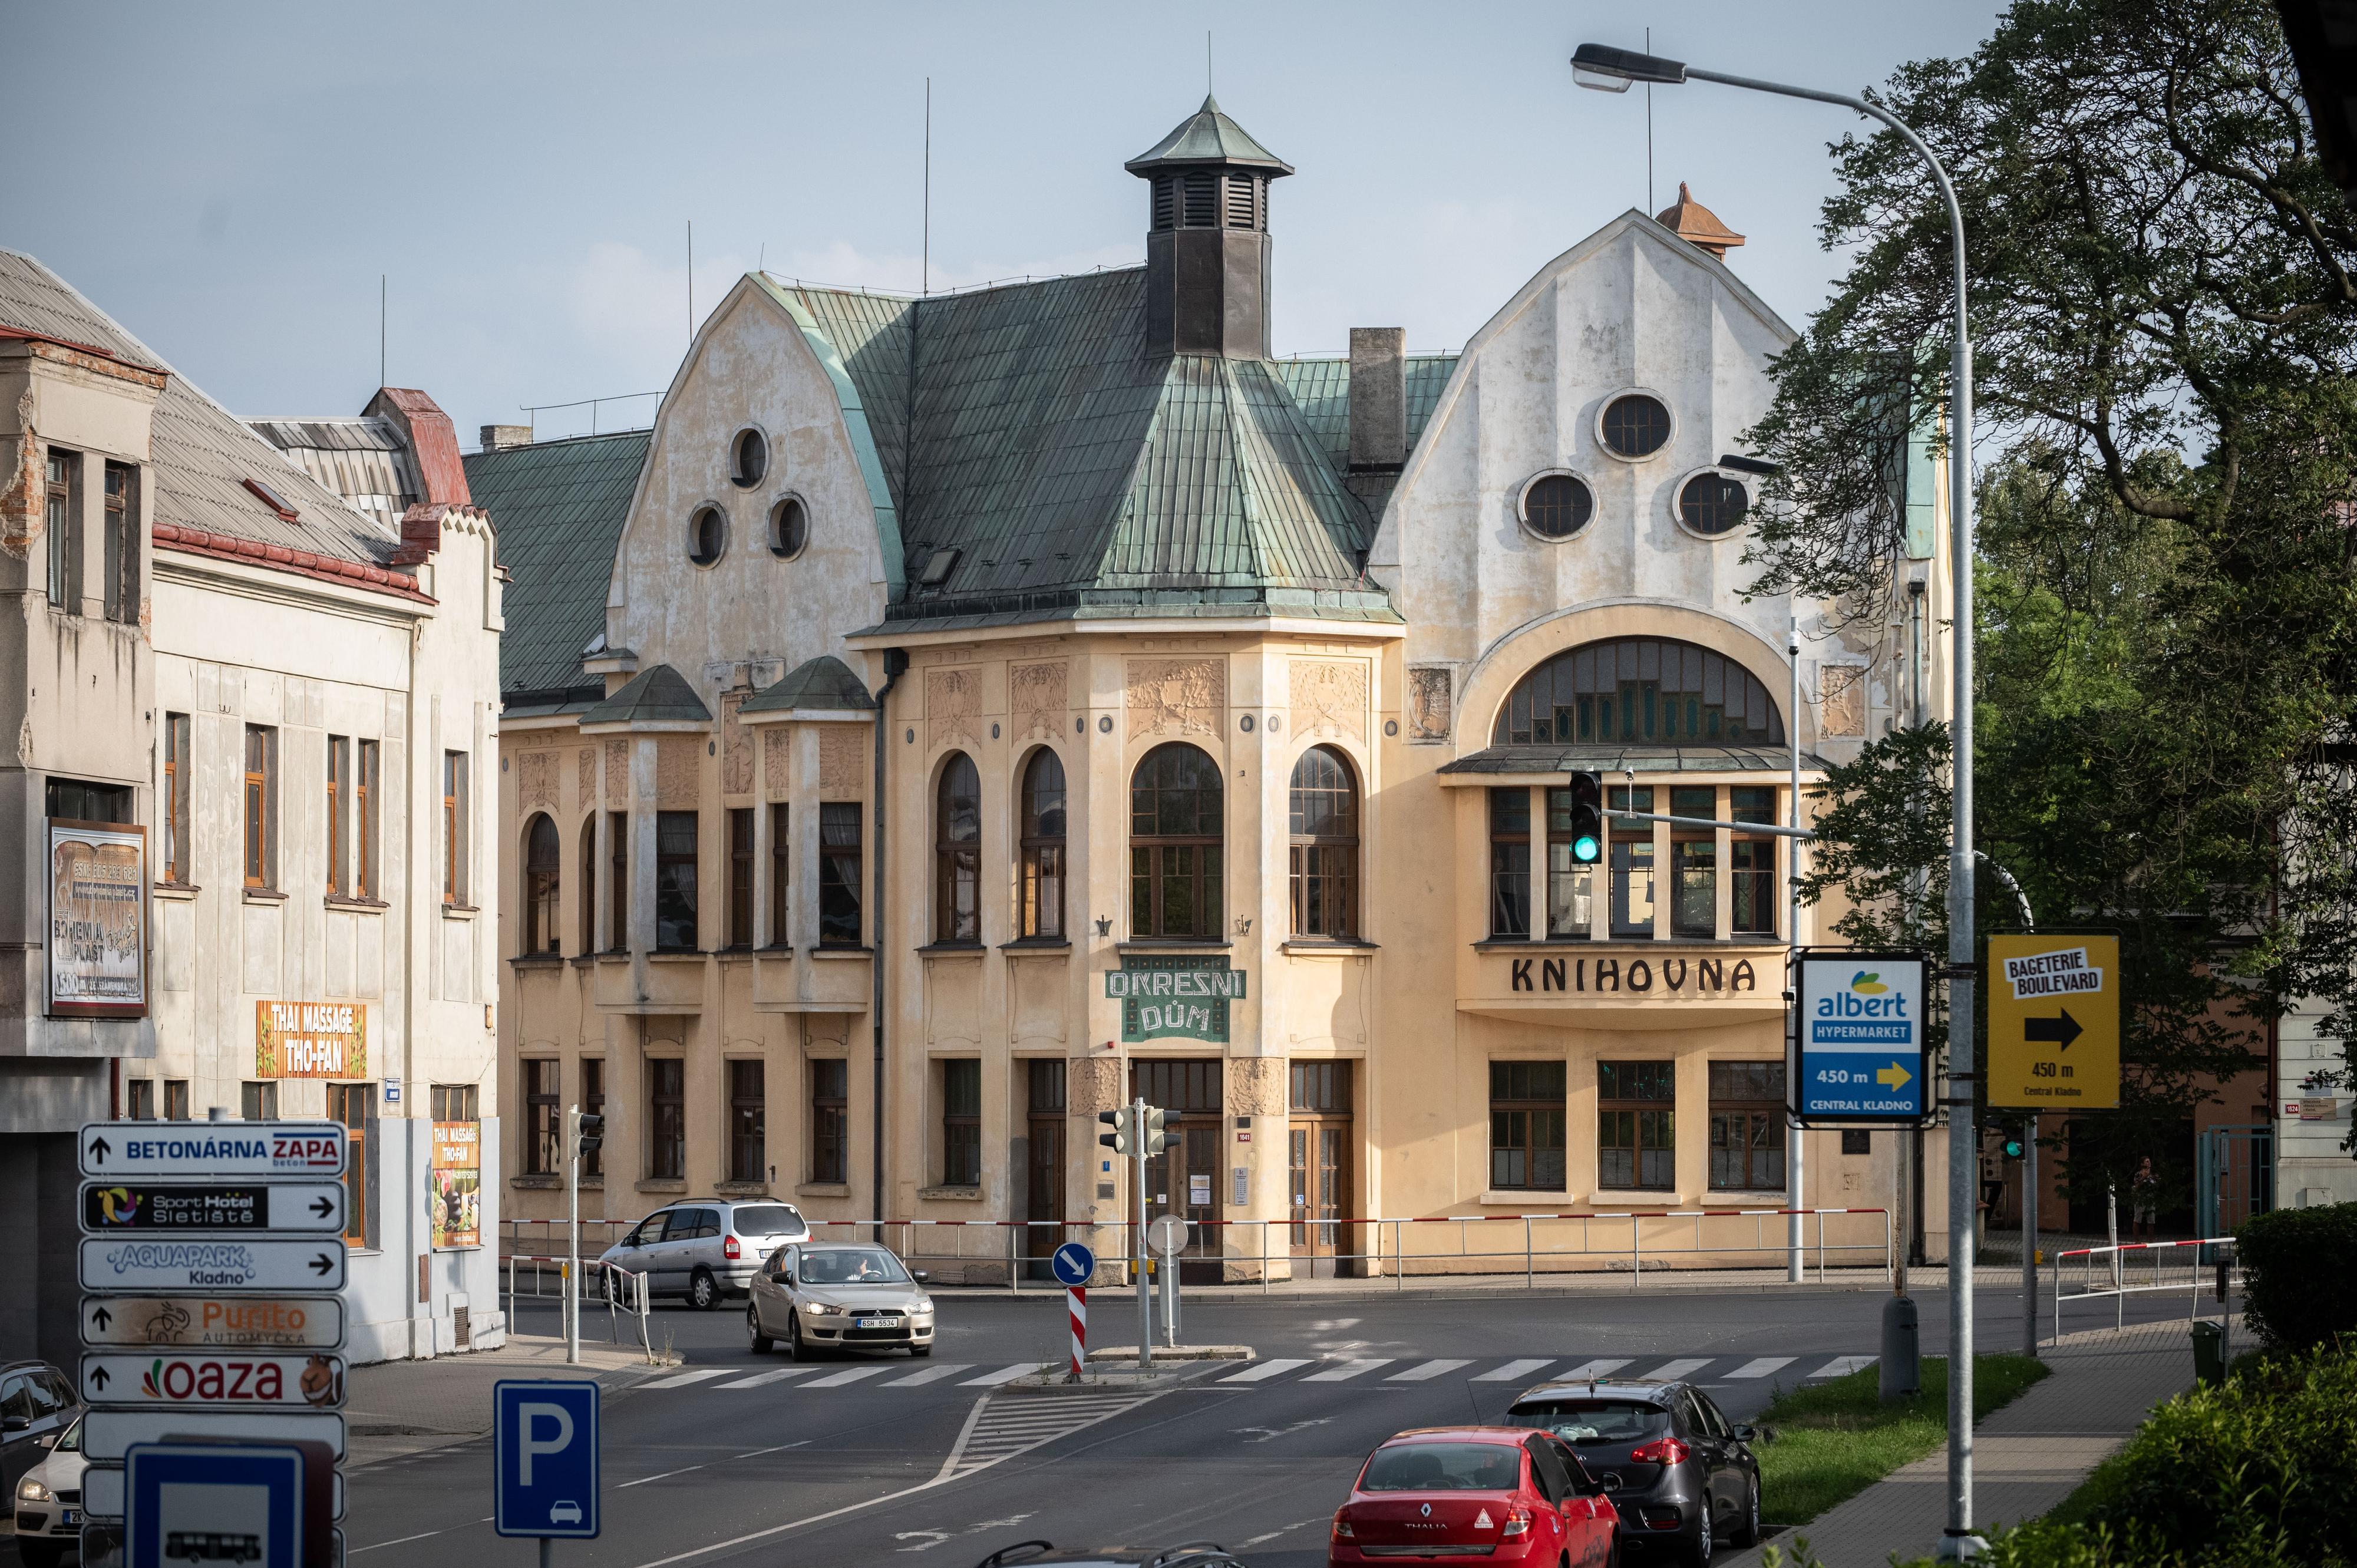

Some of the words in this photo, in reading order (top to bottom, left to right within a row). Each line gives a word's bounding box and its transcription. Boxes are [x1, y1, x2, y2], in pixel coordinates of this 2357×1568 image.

[74, 944, 104, 963] PLAST
[2009, 952, 2084, 978] BAGETERIE
[1512, 959, 1755, 991] KNIHOVNA
[2017, 972, 2098, 995] BOULEVARD
[1817, 992, 1907, 1017] albert
[272, 1005, 299, 1032] THAI
[303, 1006, 354, 1034] MASSAGE
[1141, 1000, 1209, 1031] DŮM
[1817, 1026, 1907, 1038] HYPERMARKET
[286, 1039, 342, 1072] THO-FAN
[1817, 1070, 1848, 1083] 450
[1853, 1074, 1868, 1083] m
[2032, 1062, 2056, 1077] 450
[2061, 1065, 2074, 1077] m
[2024, 1087, 2052, 1096] Central
[2055, 1087, 2081, 1096] Kladno
[1810, 1100, 1860, 1110] CENTRAL
[1863, 1101, 1913, 1110] KLADNO
[434, 1127, 448, 1143] THAI
[450, 1127, 476, 1143] MASSAGE
[127, 1137, 268, 1158] BETONÁRNA
[273, 1141, 338, 1157] ZAPA
[443, 1147, 468, 1161] THO-FAN
[153, 1196, 202, 1209] Sport
[205, 1196, 253, 1208] Hotel
[153, 1209, 253, 1223] Sletiště
[121, 1245, 246, 1268] AQUAPARK
[189, 1271, 244, 1285] Kladno
[203, 1302, 306, 1329] Purito
[203, 1330, 305, 1342] AUTOMYČKA
[164, 1362, 283, 1399] oaza
[519, 1402, 574, 1486] P
